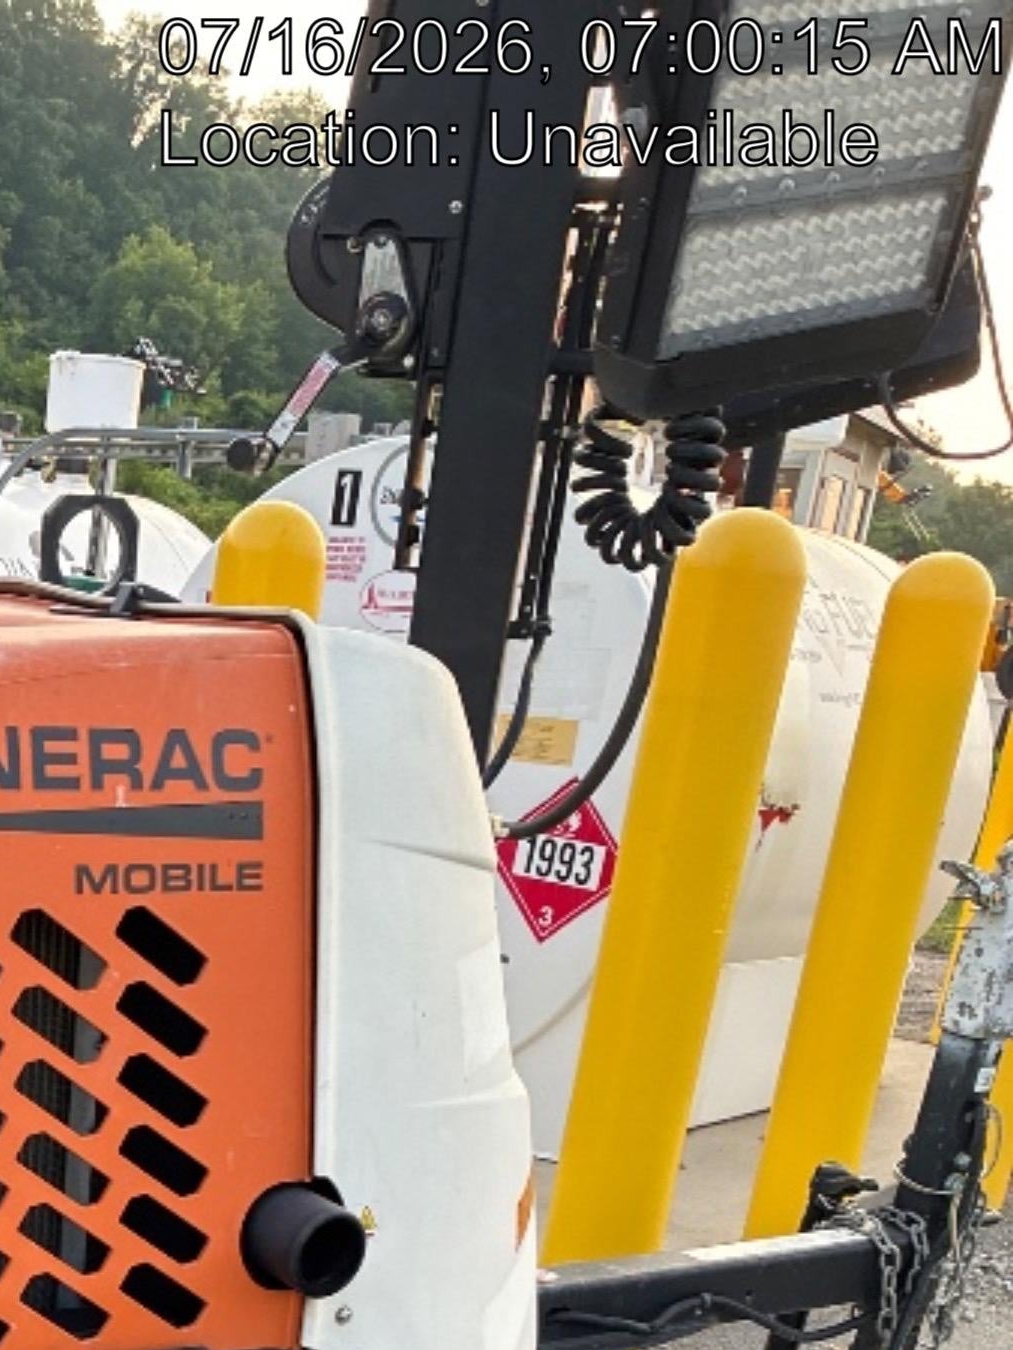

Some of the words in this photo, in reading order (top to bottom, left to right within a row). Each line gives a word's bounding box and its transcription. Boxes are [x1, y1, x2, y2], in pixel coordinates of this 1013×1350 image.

[73, 861, 264, 895] MOBILE
[523, 837, 595, 886] 1993
[537, 904, 554, 927] 3
